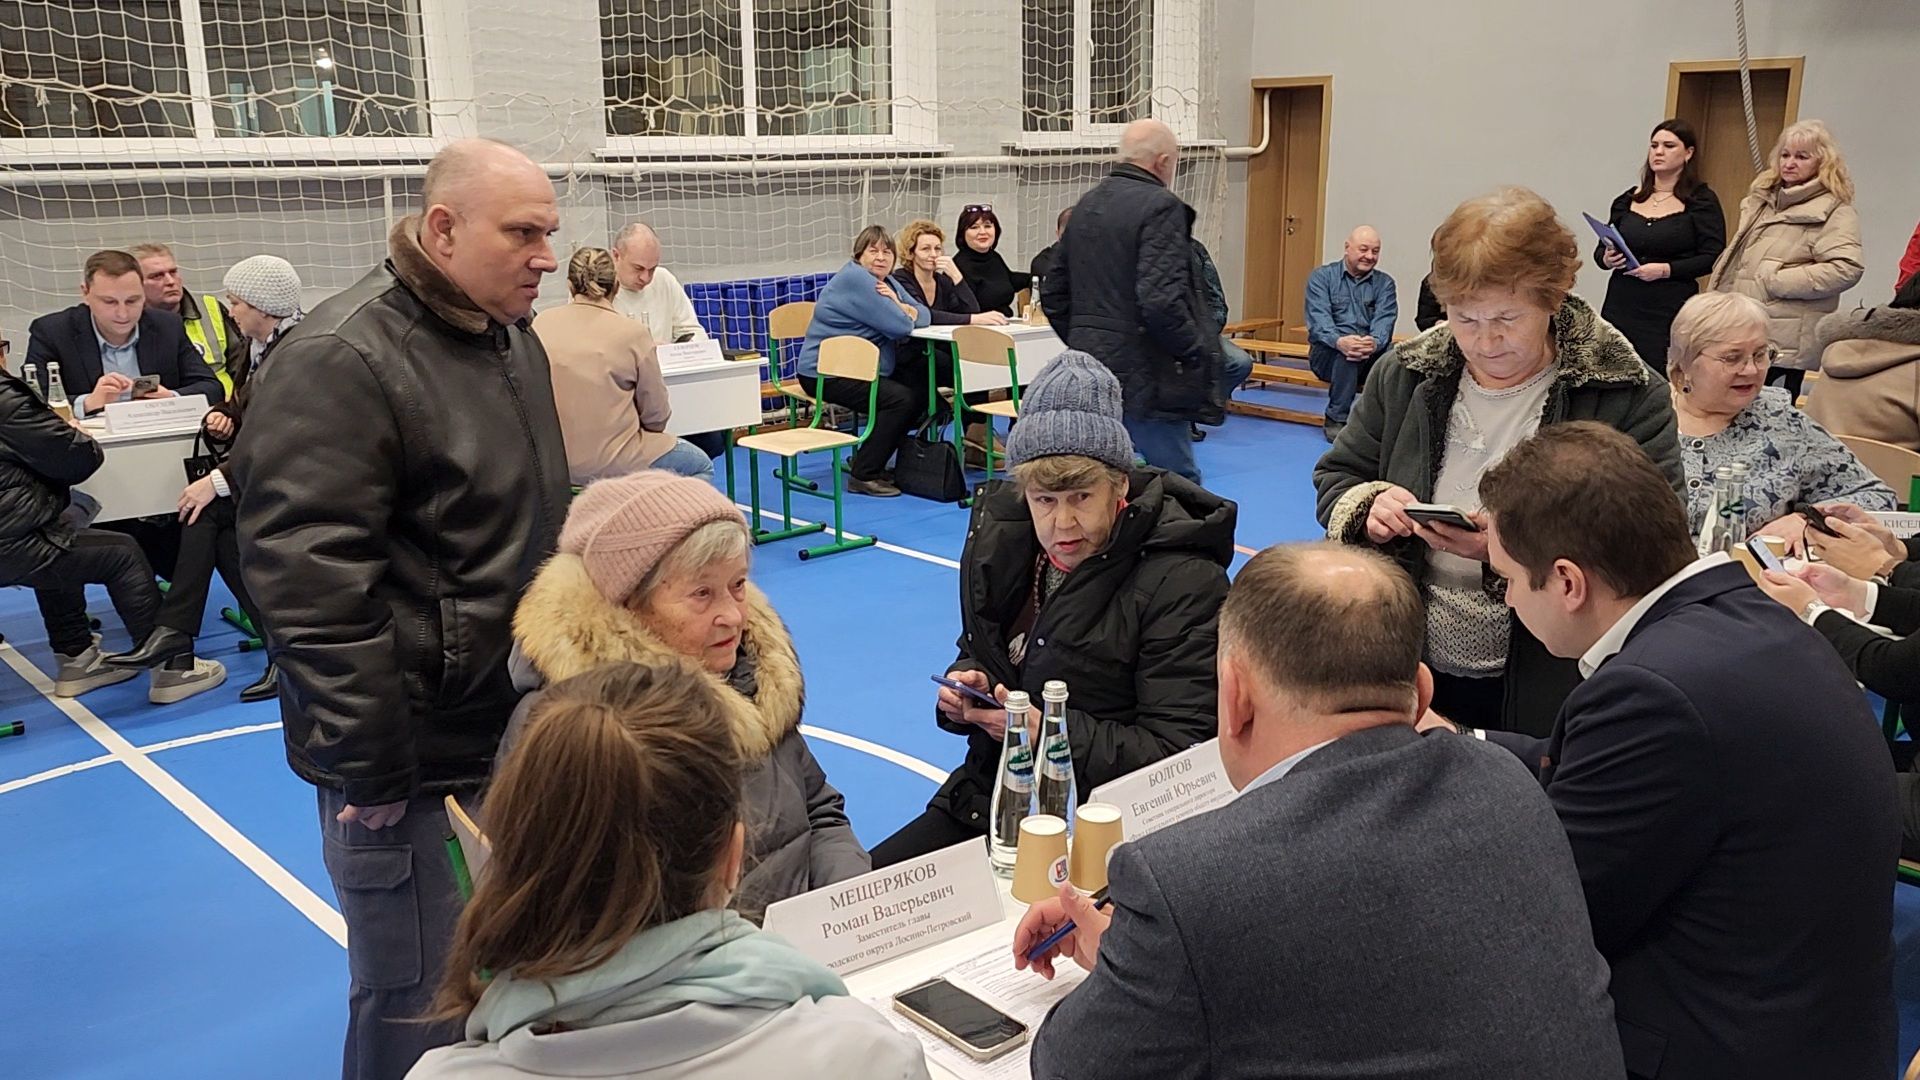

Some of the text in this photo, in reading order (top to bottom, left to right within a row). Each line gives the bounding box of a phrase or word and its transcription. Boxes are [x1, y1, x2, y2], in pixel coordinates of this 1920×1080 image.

[1131, 771, 1217, 816] Евгений Юрьевич
[1149, 758, 1192, 787] БОЛГОВ
[829, 863, 937, 911] МЕЩЕРЯКОВ
[822, 885, 955, 939] Роман Валерьевич
[856, 912, 931, 944] Заместитель главы
[866, 940, 894, 957] округа
[895, 911, 972, 946] Лосино-Петровский
